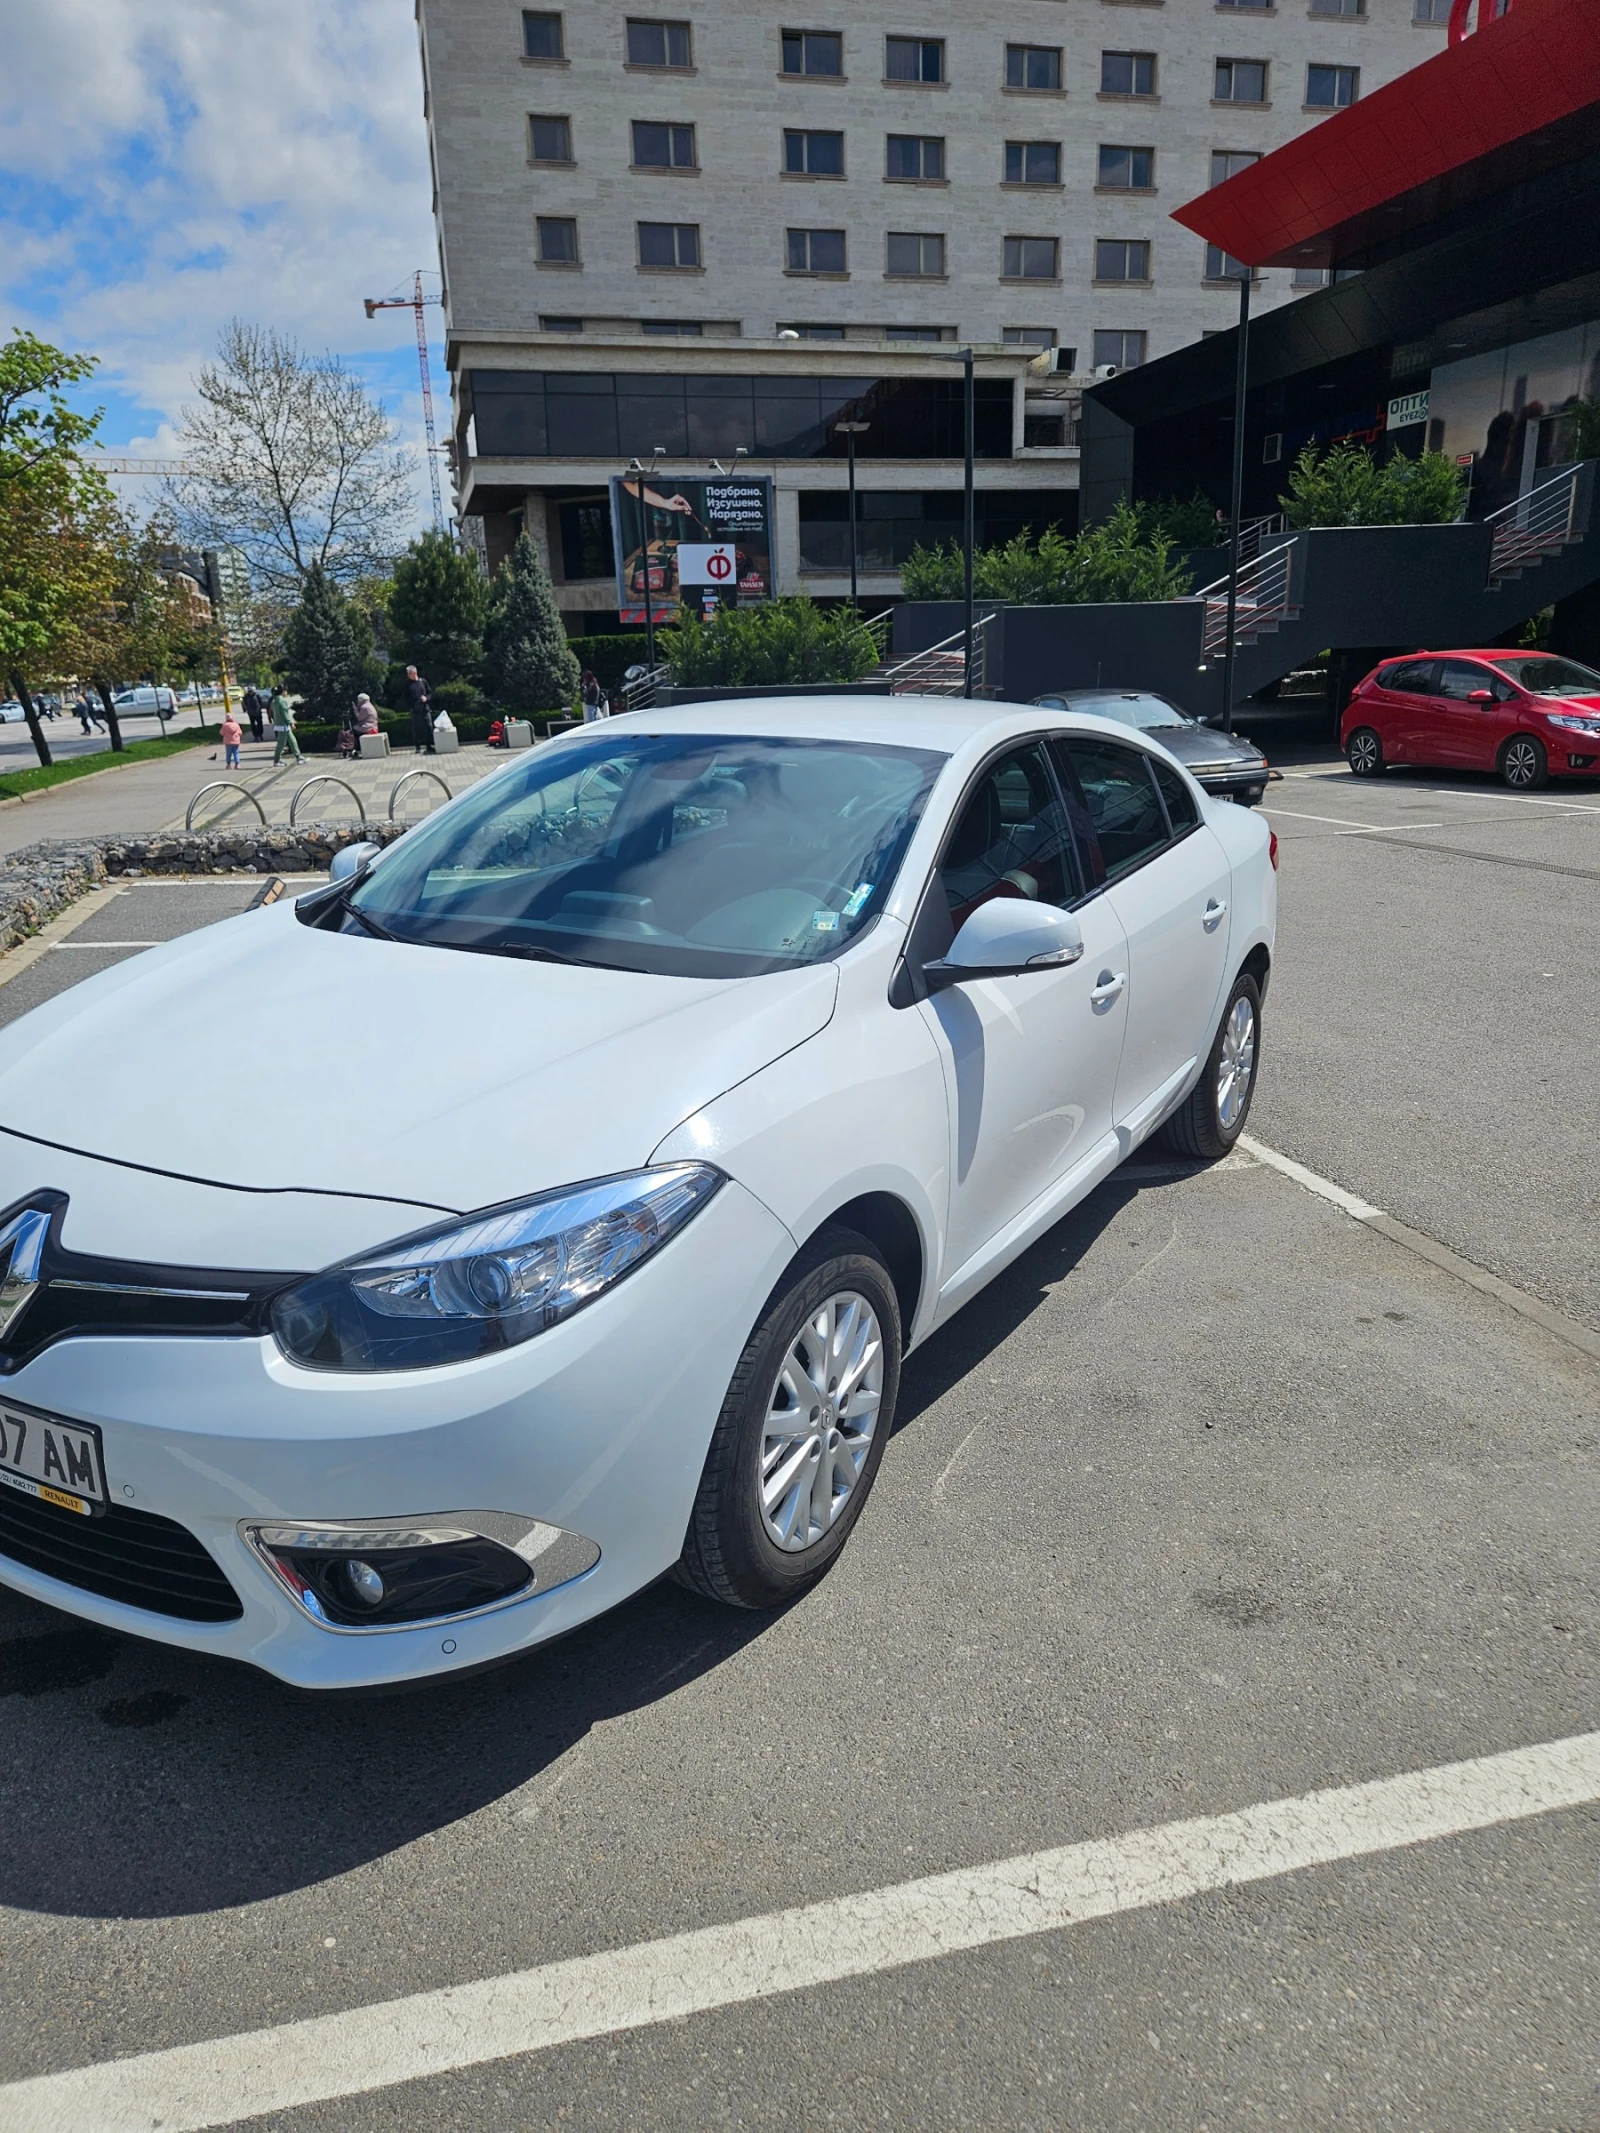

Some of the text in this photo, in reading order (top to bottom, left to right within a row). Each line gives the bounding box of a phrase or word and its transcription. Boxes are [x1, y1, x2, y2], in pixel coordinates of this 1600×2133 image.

[706, 486, 762, 498] Подбрано.
[707, 498, 763, 509] Изсушено.
[709, 510, 763, 521] Нарязано.
[44, 1428, 97, 1493] AM
[44, 1489, 80, 1509] RENAULT
